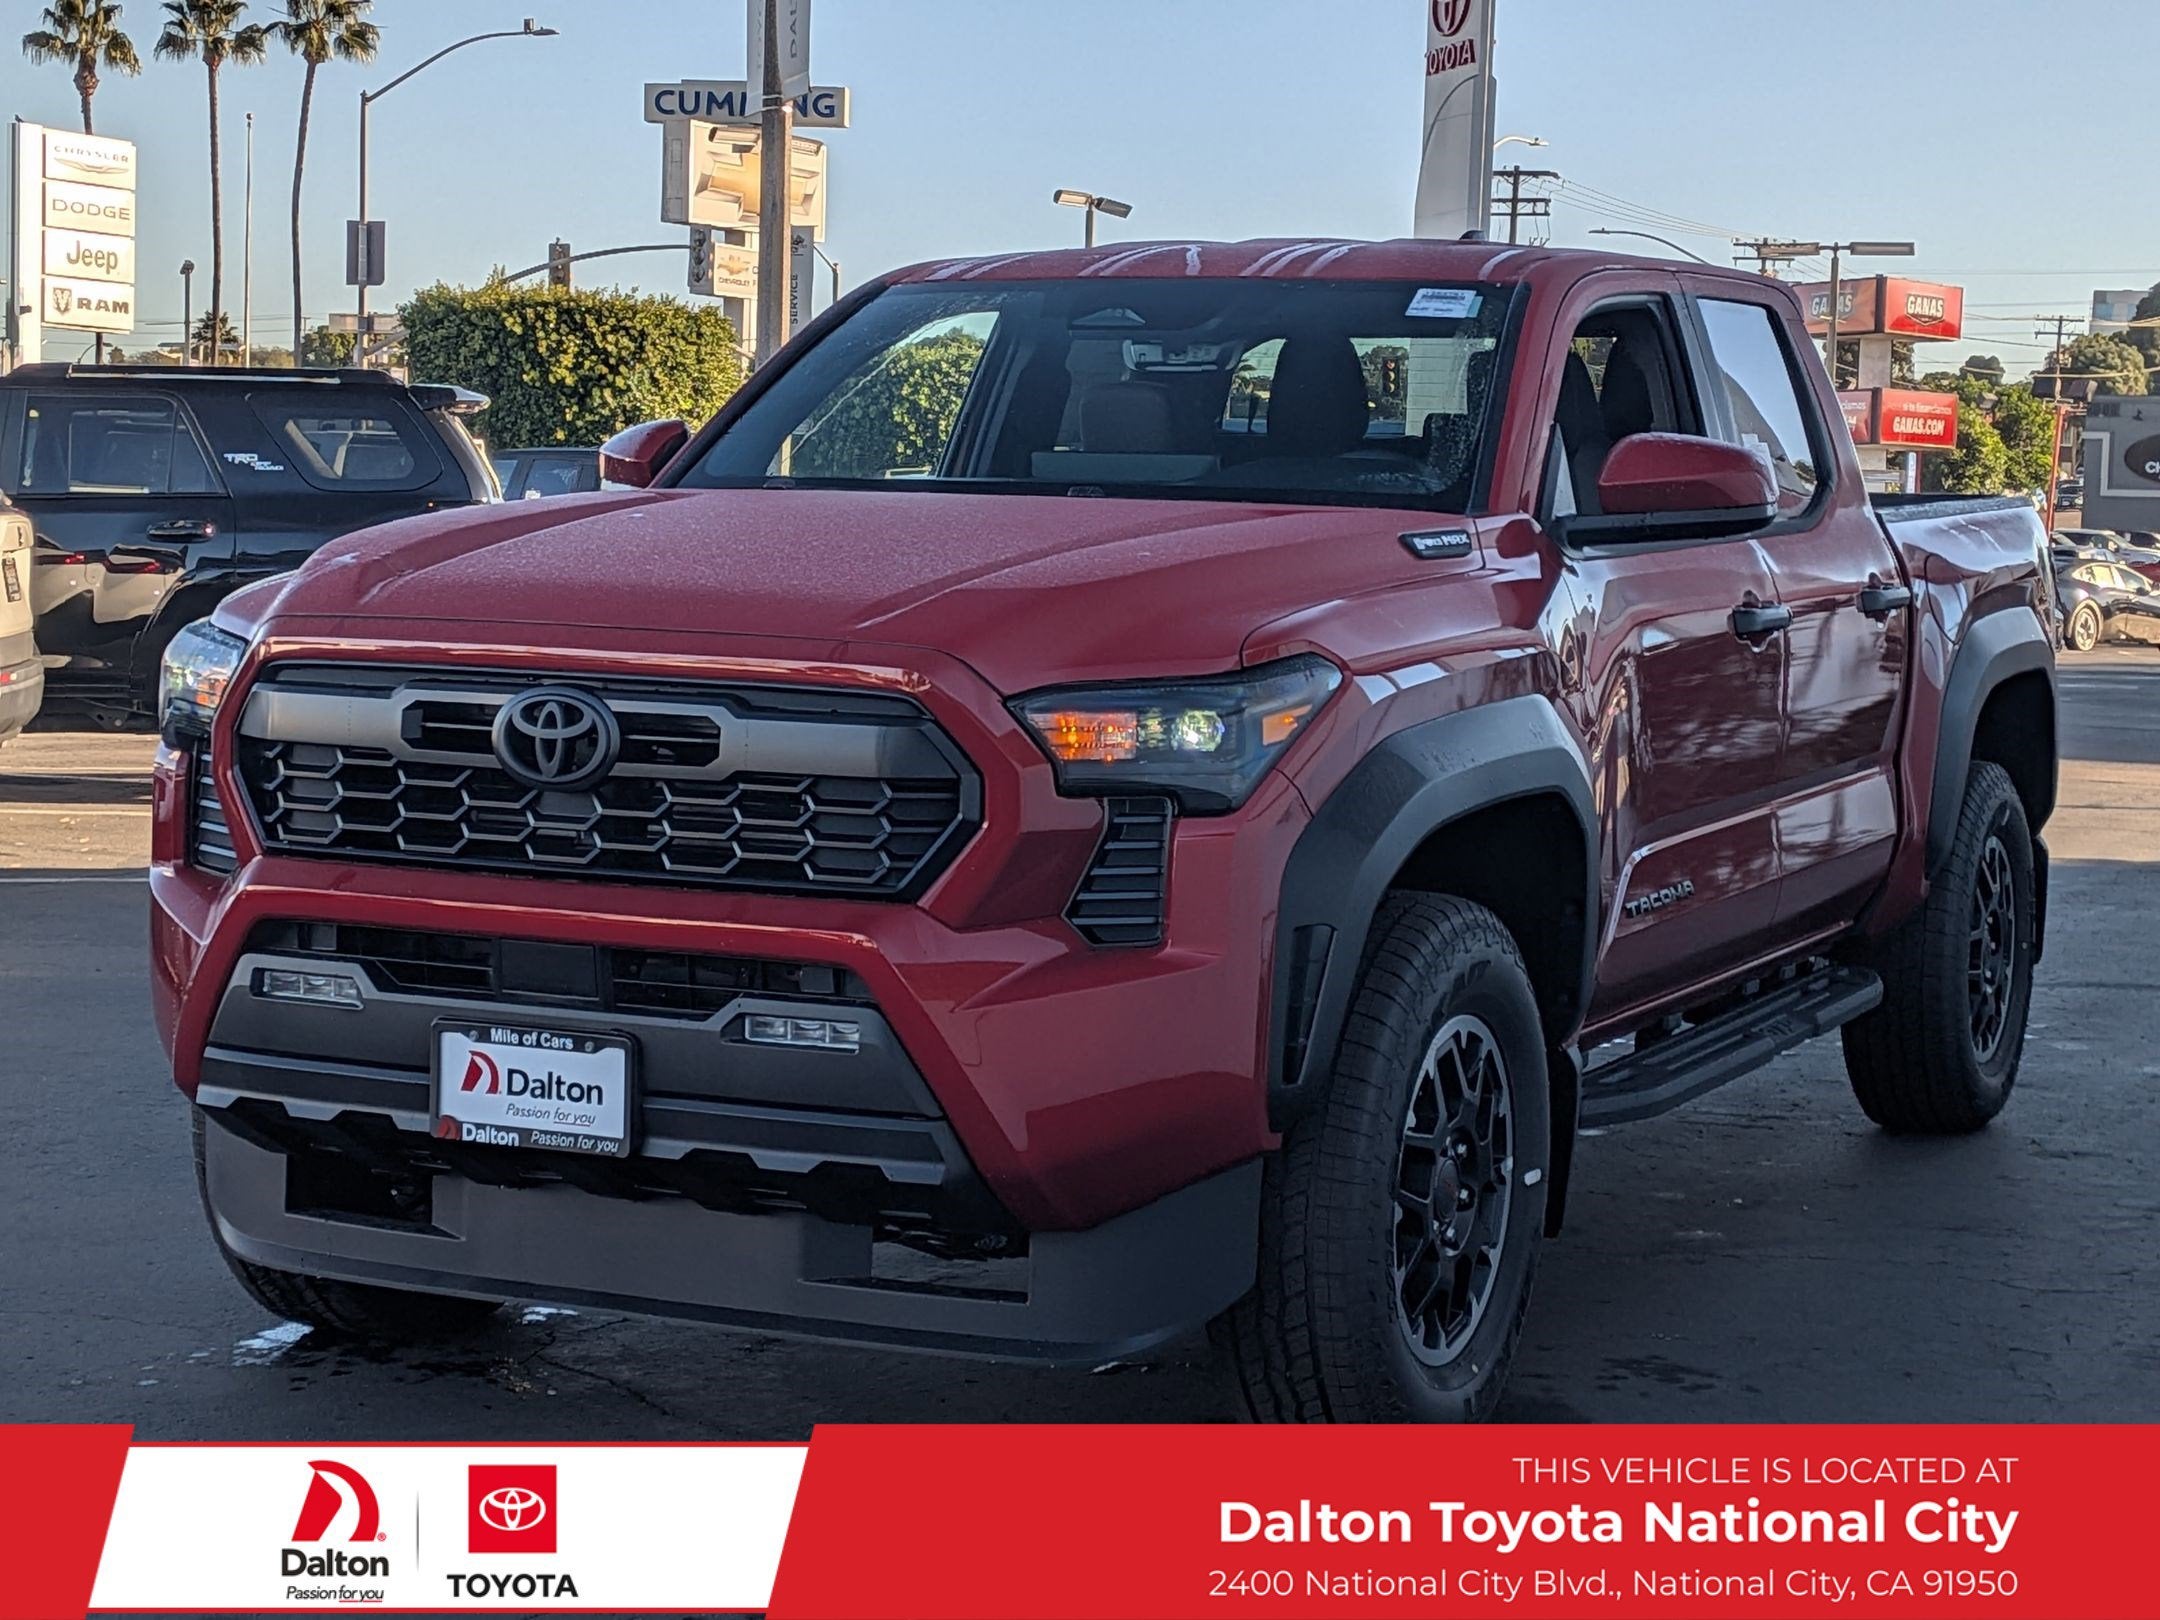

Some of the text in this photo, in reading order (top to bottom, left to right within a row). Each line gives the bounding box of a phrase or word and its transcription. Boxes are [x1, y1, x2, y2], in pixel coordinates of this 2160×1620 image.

[654, 89, 836, 118] CUMNG
[52, 198, 131, 221] DODGE
[66, 240, 119, 275] Jeep
[77, 297, 130, 315] RAM
[790, 274, 799, 325] SERVICE
[1812, 294, 1853, 315] GAAS
[1907, 295, 1944, 318] GANAS
[1893, 416, 1946, 436] GANAS.COM
[1625, 880, 1695, 917] TACOMA
[490, 1027, 574, 1050] Mile of Cars
[506, 1068, 604, 1106] Dalton
[506, 1103, 596, 1126] Passion for you
[462, 1123, 620, 1154] Dalton Passion for you
